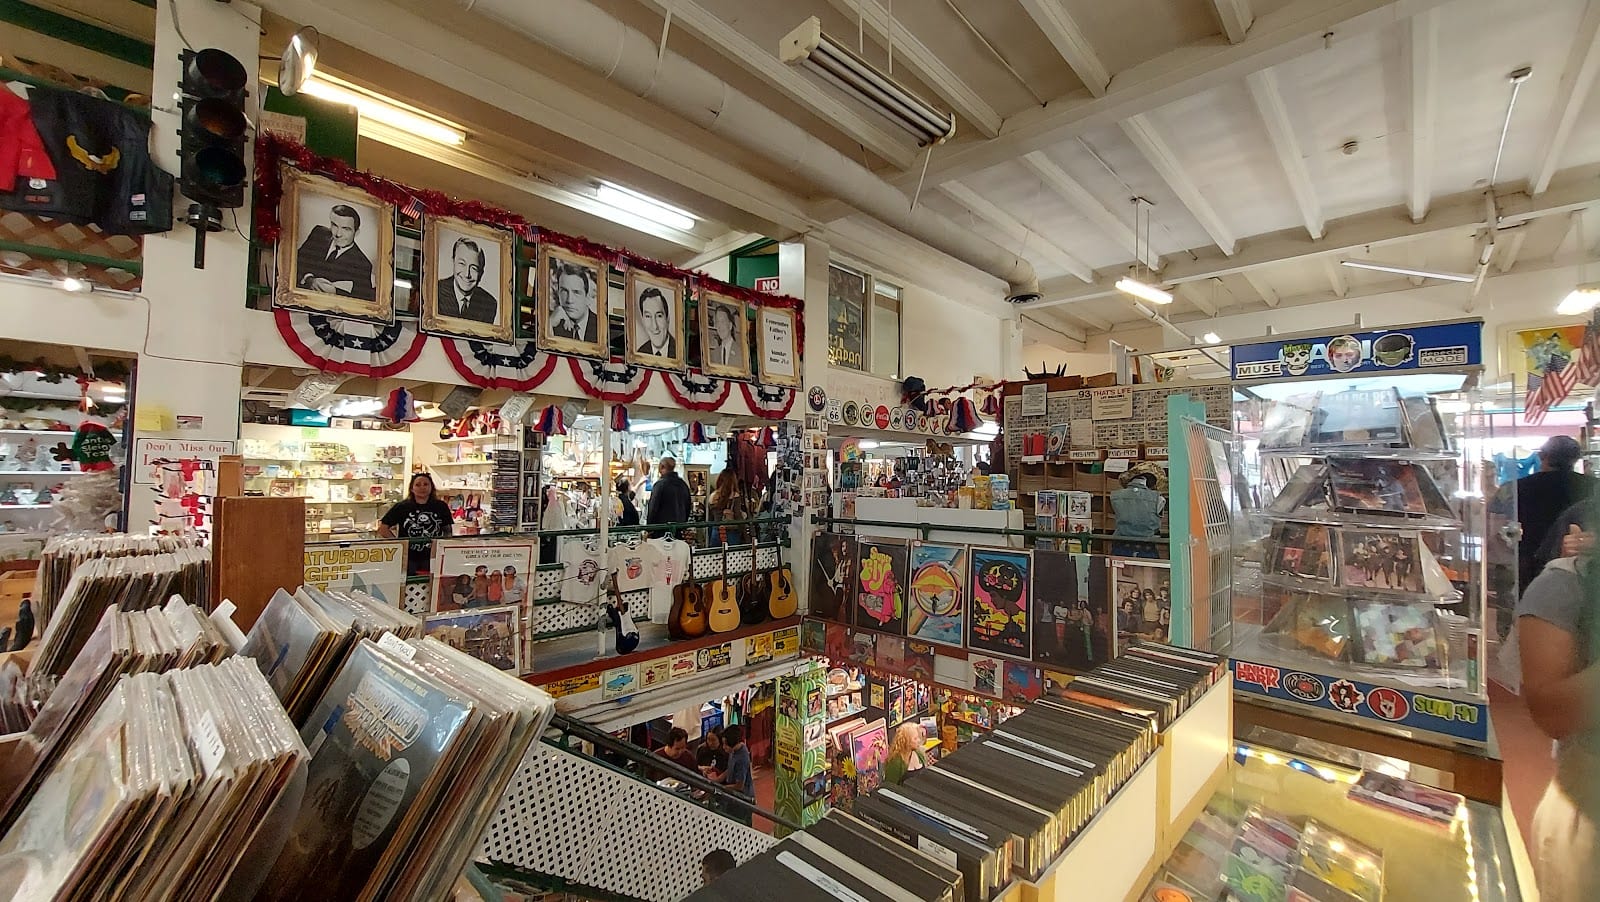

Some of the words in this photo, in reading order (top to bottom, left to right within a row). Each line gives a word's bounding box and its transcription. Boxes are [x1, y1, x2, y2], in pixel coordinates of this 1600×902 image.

[762, 280, 778, 290] NO
[1422, 355, 1464, 364] MODE
[1239, 364, 1280, 375] MUSE
[1078, 390, 1091, 399] 93
[1093, 388, 1116, 397] THAT'S
[1117, 387, 1131, 395] LIFE
[829, 411, 839, 420] 66
[146, 442, 172, 451] Don't
[180, 444, 204, 452] Miss
[209, 444, 227, 453] Our
[304, 547, 398, 566] ATURDaY
[304, 565, 352, 583] GHT
[1237, 662, 1279, 675] LINKIN
[547, 679, 573, 690] FOLLOW
[1237, 671, 1279, 689] PARK
